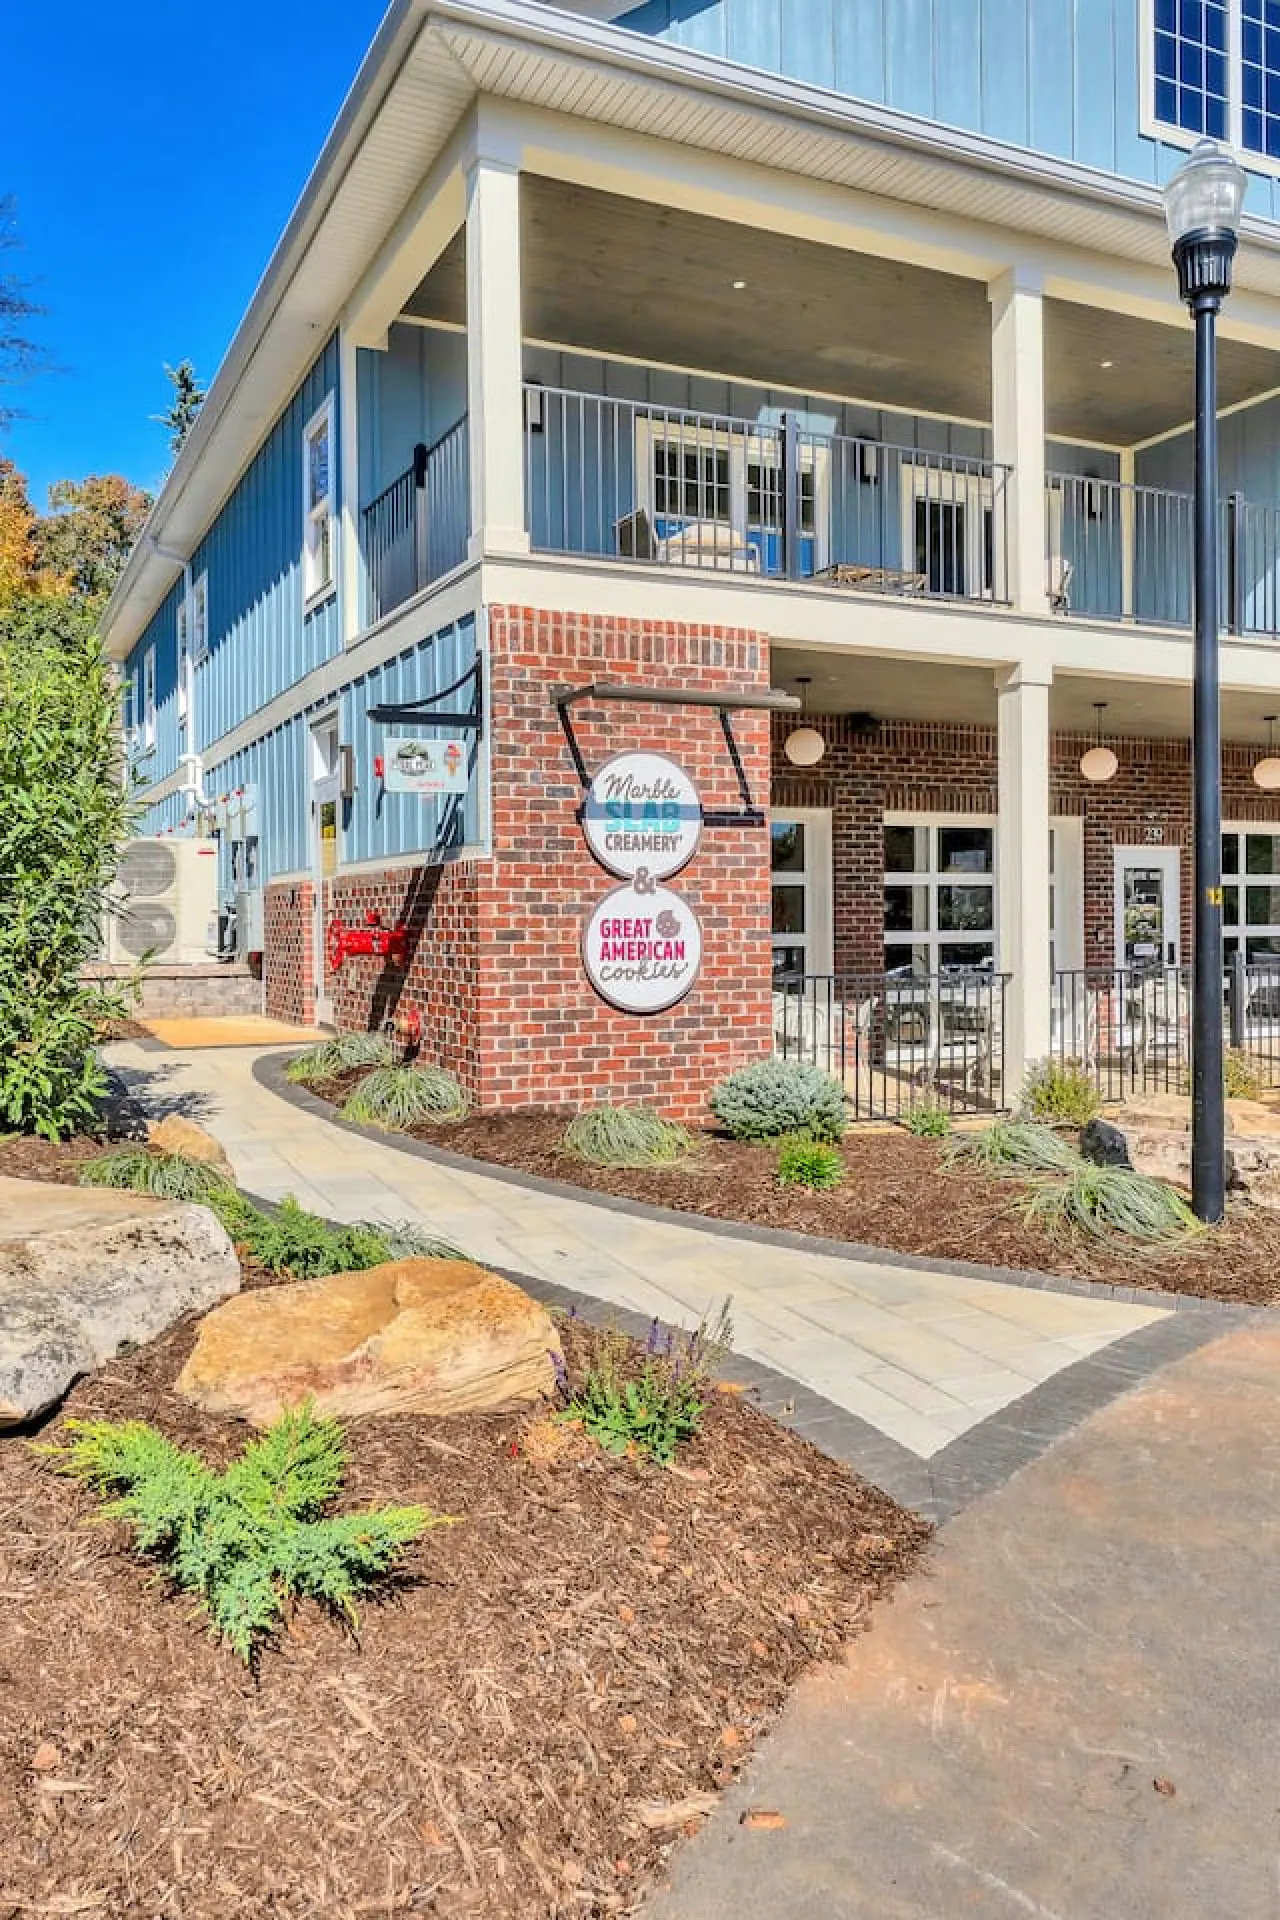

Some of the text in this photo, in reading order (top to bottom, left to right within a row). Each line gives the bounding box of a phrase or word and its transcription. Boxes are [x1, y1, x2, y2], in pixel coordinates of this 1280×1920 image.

[604, 773, 681, 800] Marble
[605, 801, 680, 832] SLAB
[605, 835, 680, 851] CREAMERY
[633, 866, 657, 895] &
[600, 918, 653, 939] GREAT
[600, 941, 685, 961] AMERICAN
[600, 957, 689, 980] cookies
